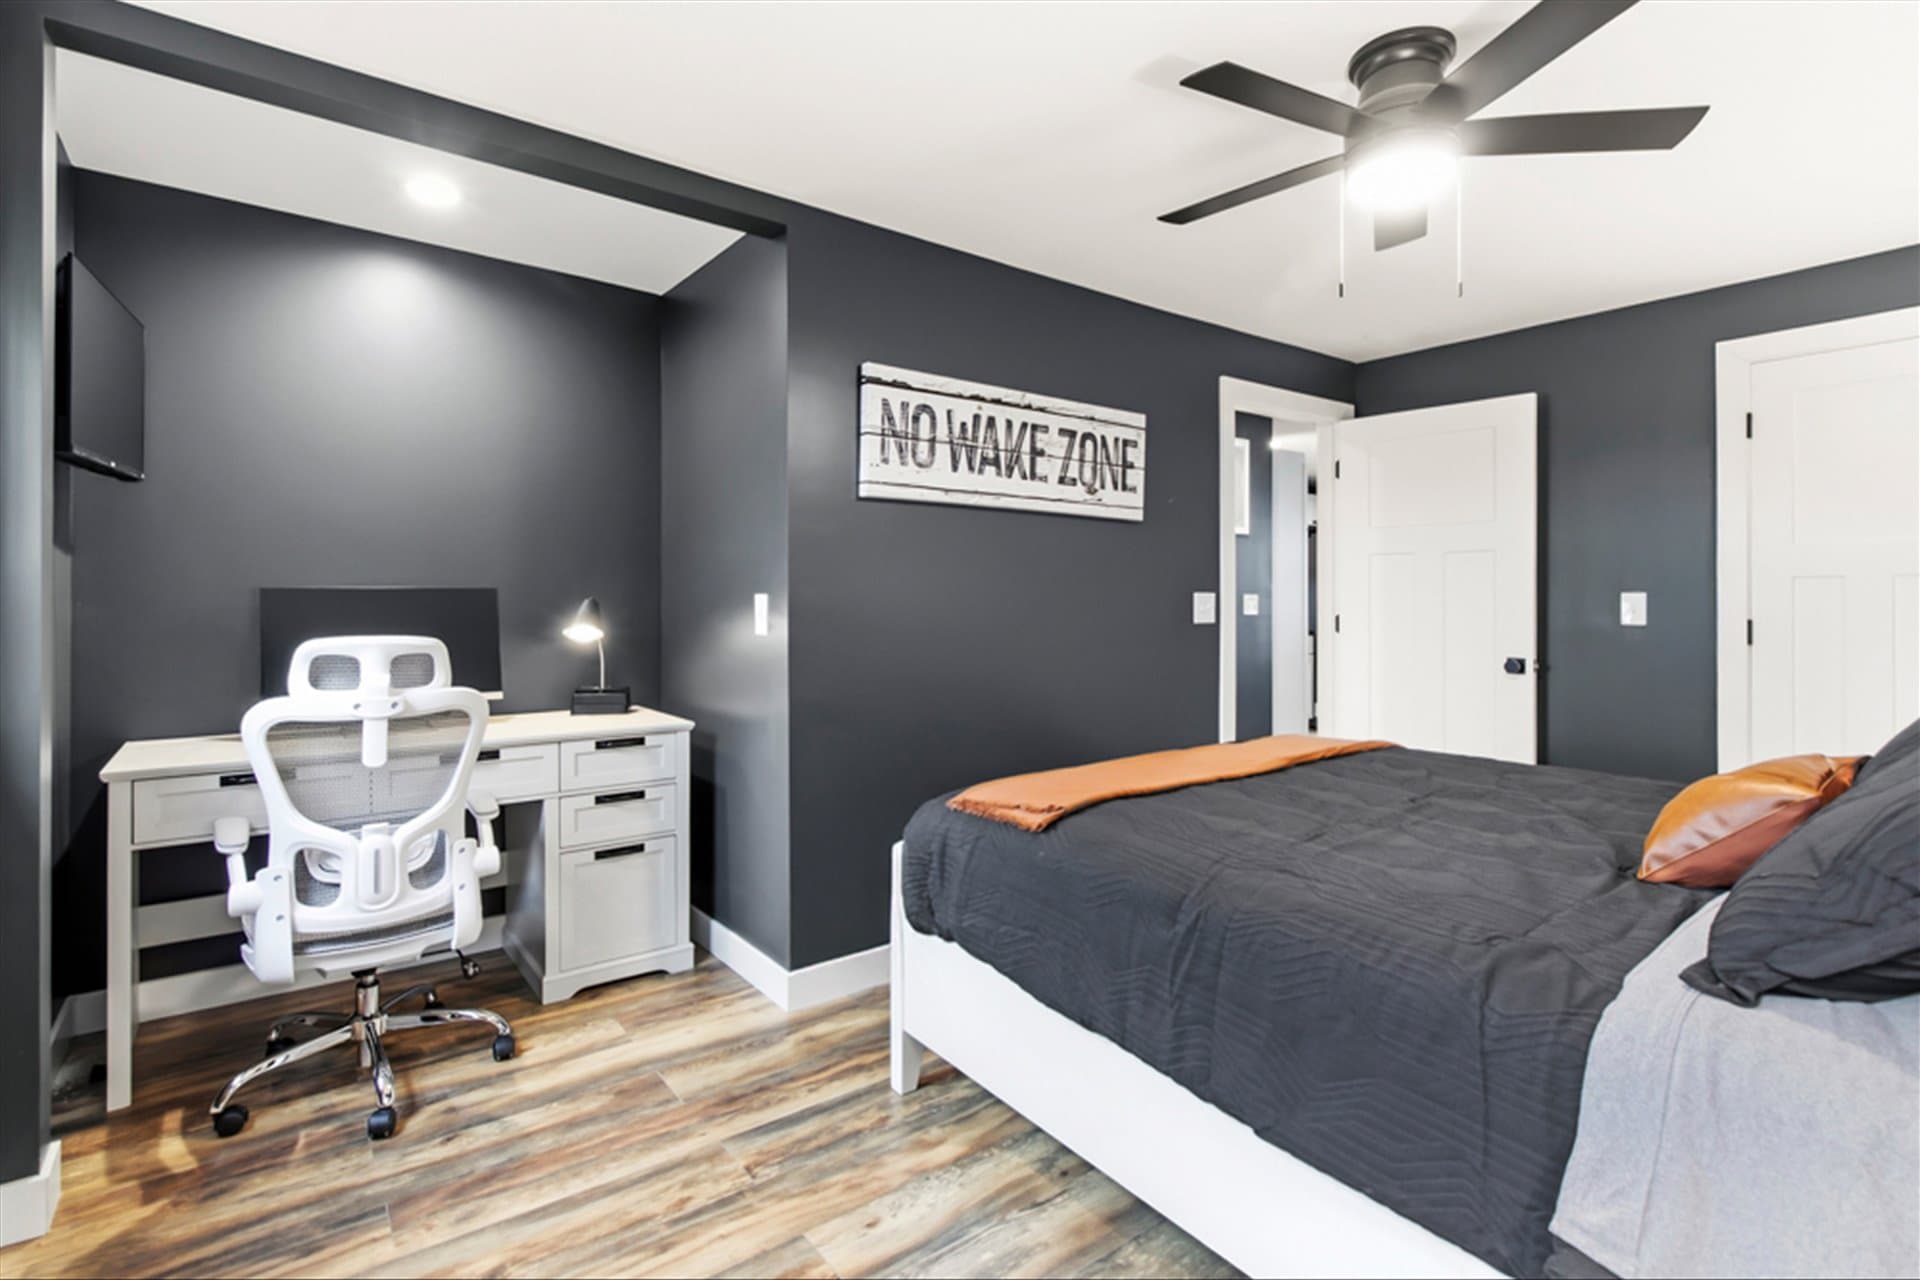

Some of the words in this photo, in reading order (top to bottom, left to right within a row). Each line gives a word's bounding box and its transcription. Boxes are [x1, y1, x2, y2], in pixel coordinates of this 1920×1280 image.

[880, 398, 937, 468] NO
[947, 409, 1048, 482] WAKE
[1057, 427, 1138, 493] ZONE
